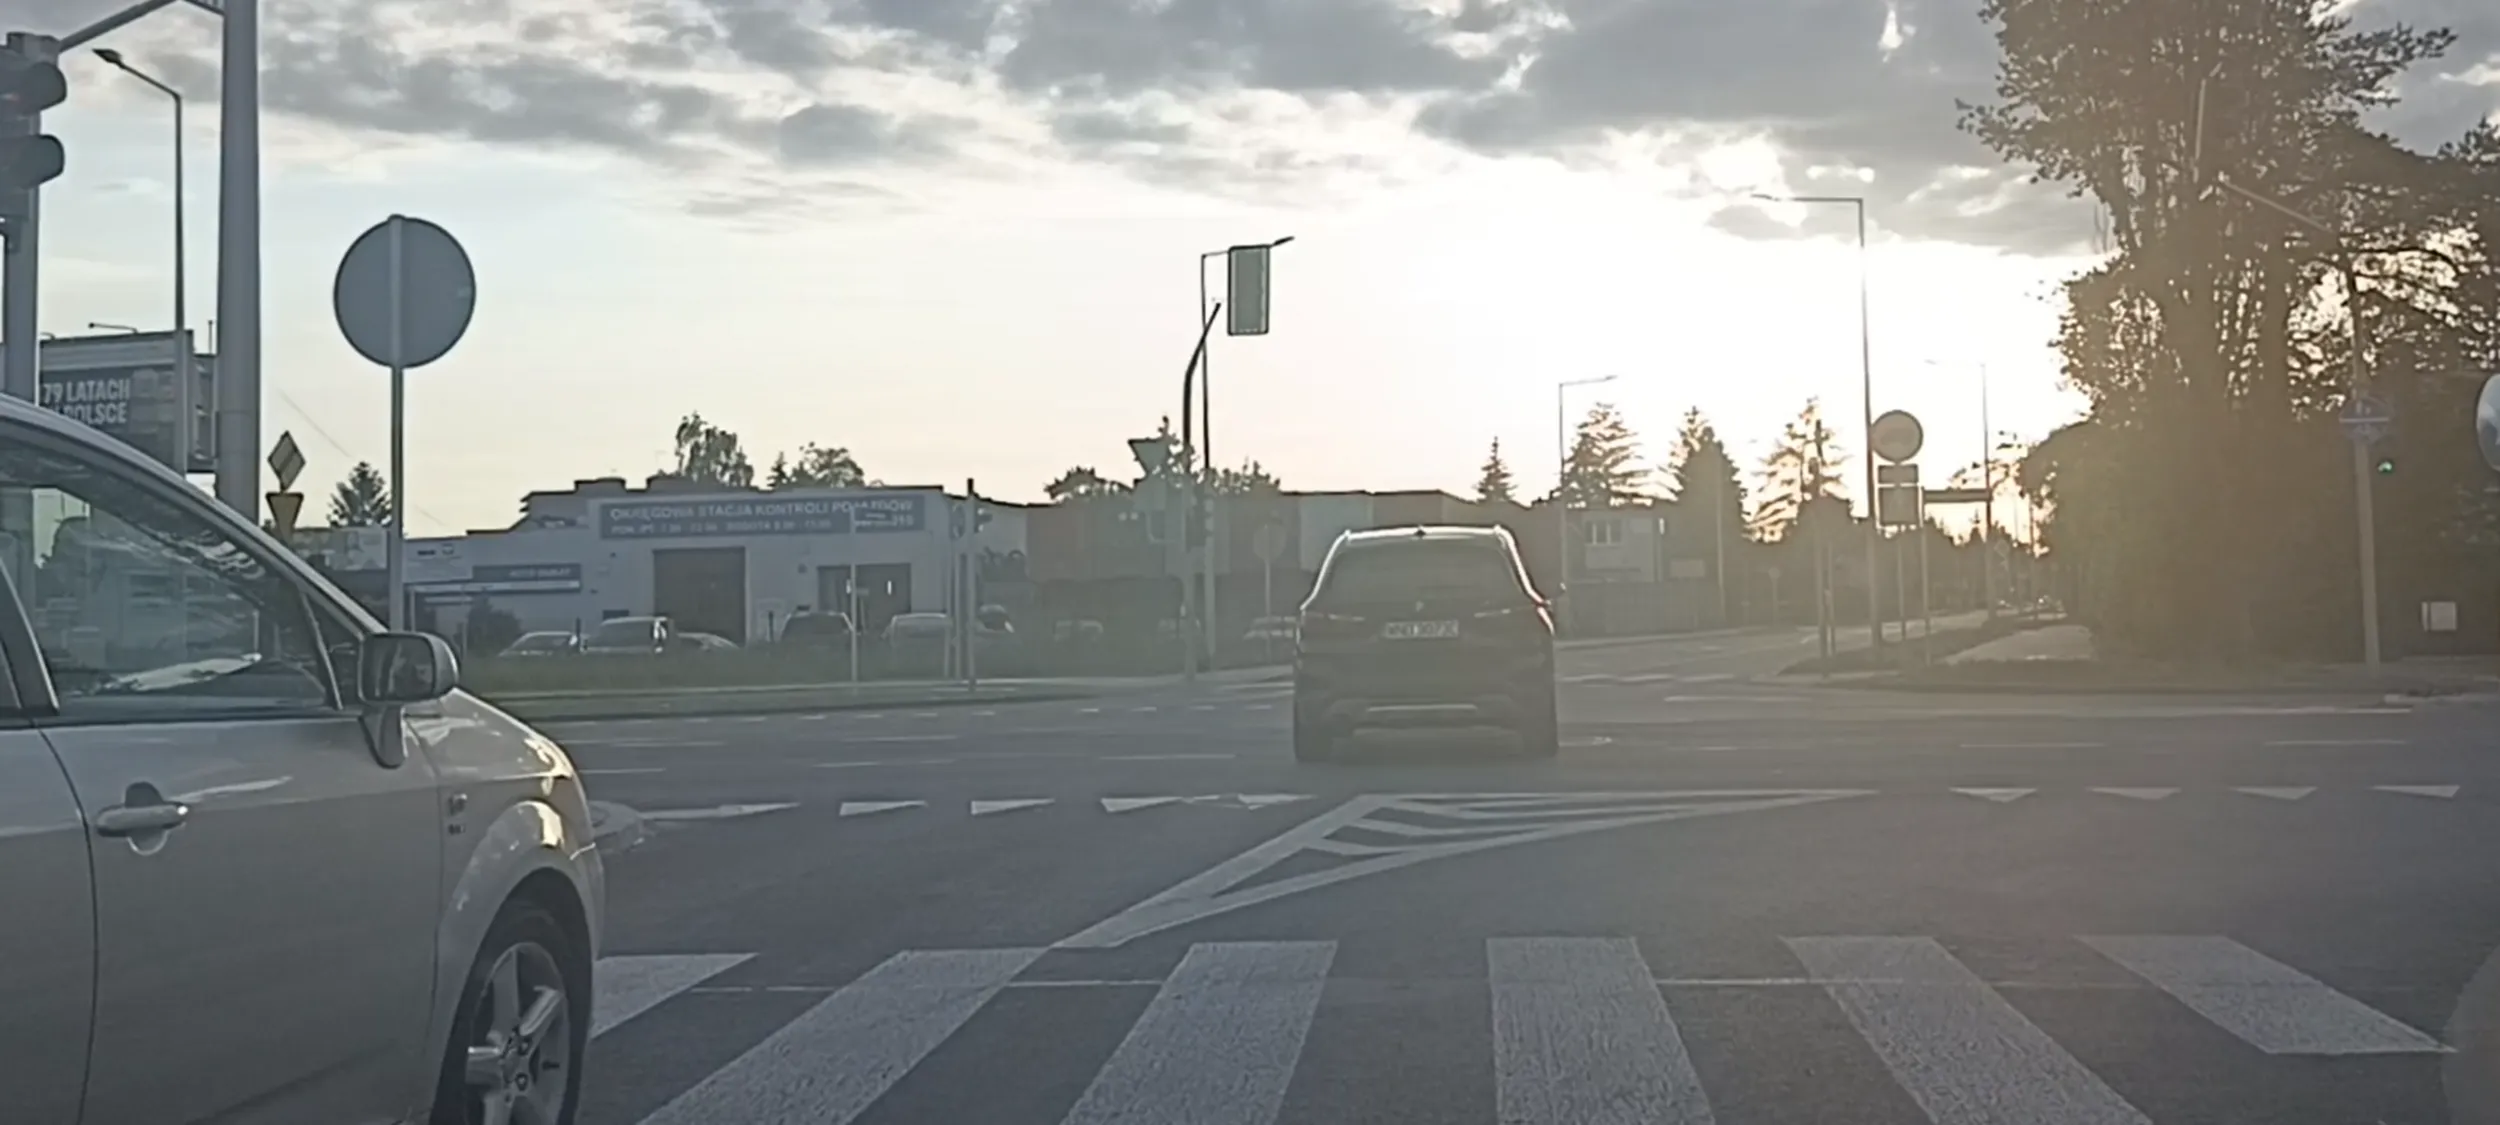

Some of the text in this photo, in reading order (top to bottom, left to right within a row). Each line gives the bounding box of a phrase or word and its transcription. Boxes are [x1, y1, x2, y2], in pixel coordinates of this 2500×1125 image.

[67, 379, 130, 402] LATACH
[698, 504, 752, 519] STACJA
[755, 502, 828, 517] KONTROLI
